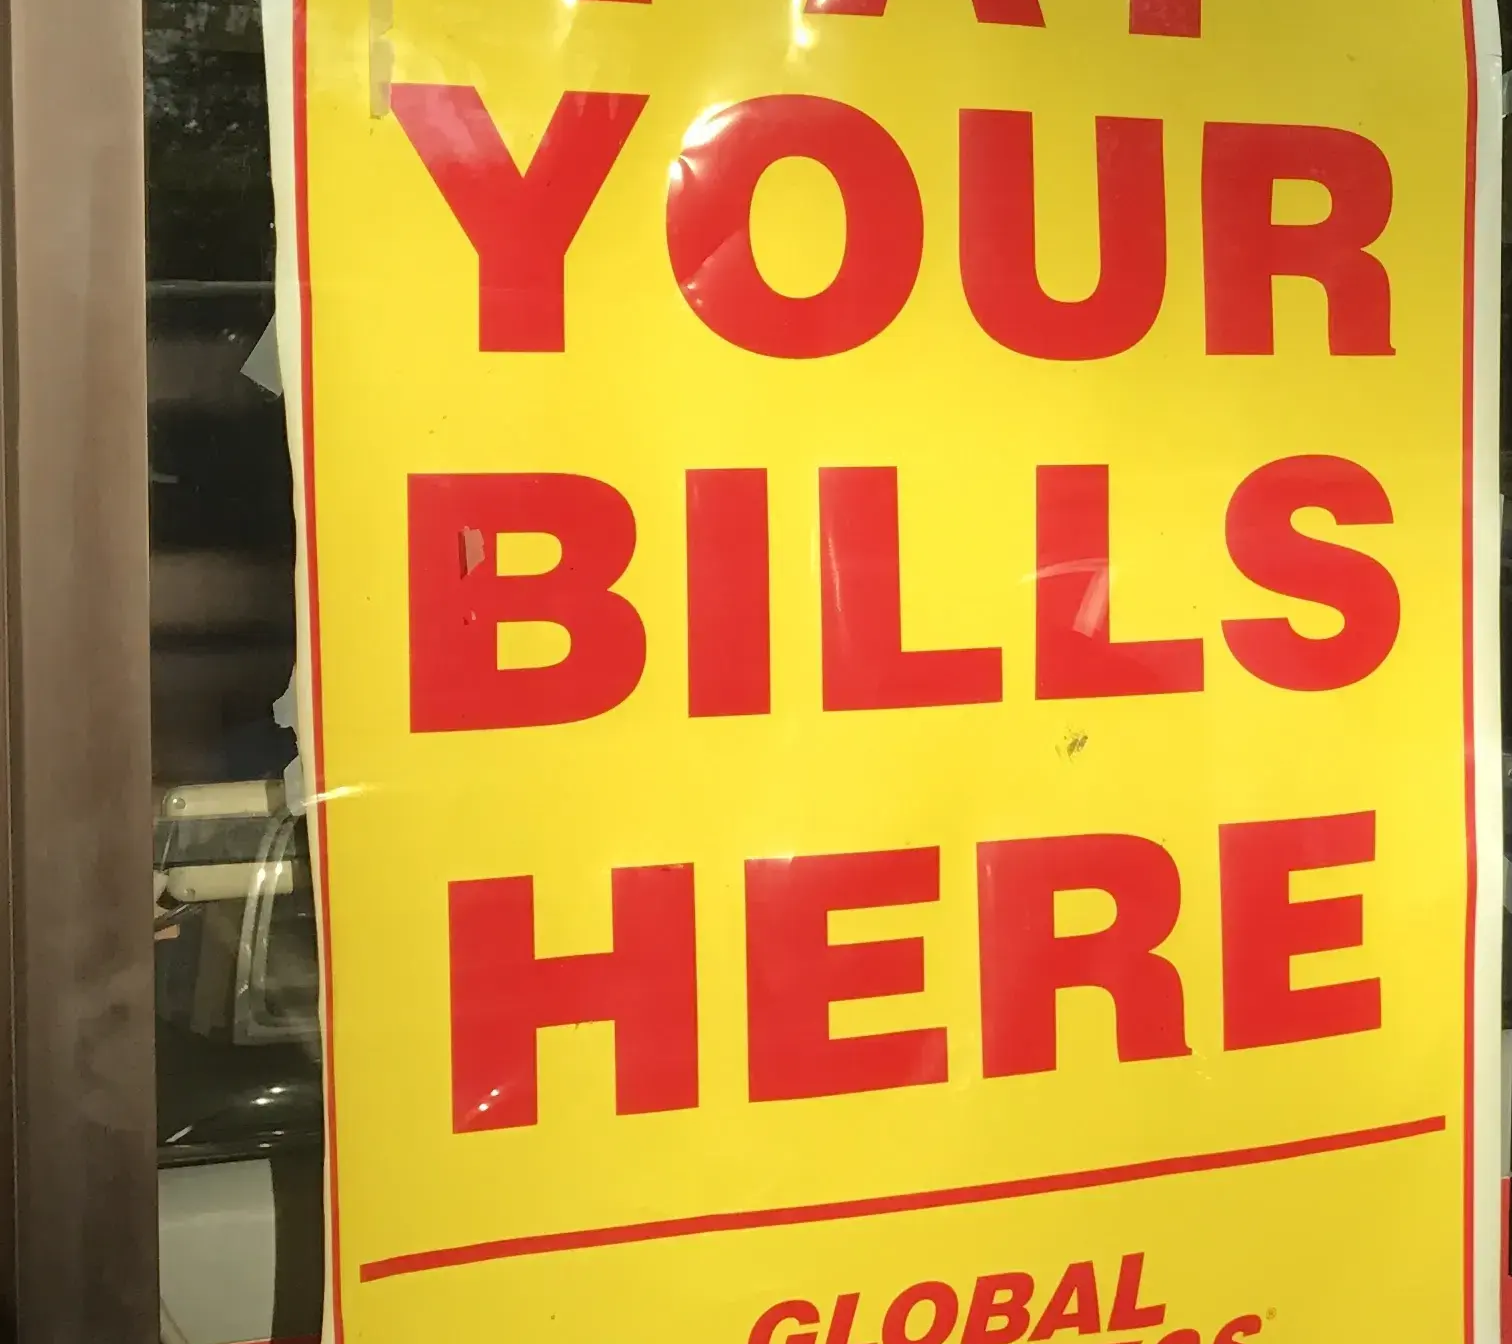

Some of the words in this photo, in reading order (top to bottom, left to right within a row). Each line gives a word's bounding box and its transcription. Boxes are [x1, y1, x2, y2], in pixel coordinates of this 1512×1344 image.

[390, 84, 1396, 362] YOUR
[407, 454, 1401, 734] BILLS
[448, 811, 1382, 1135] HERE
